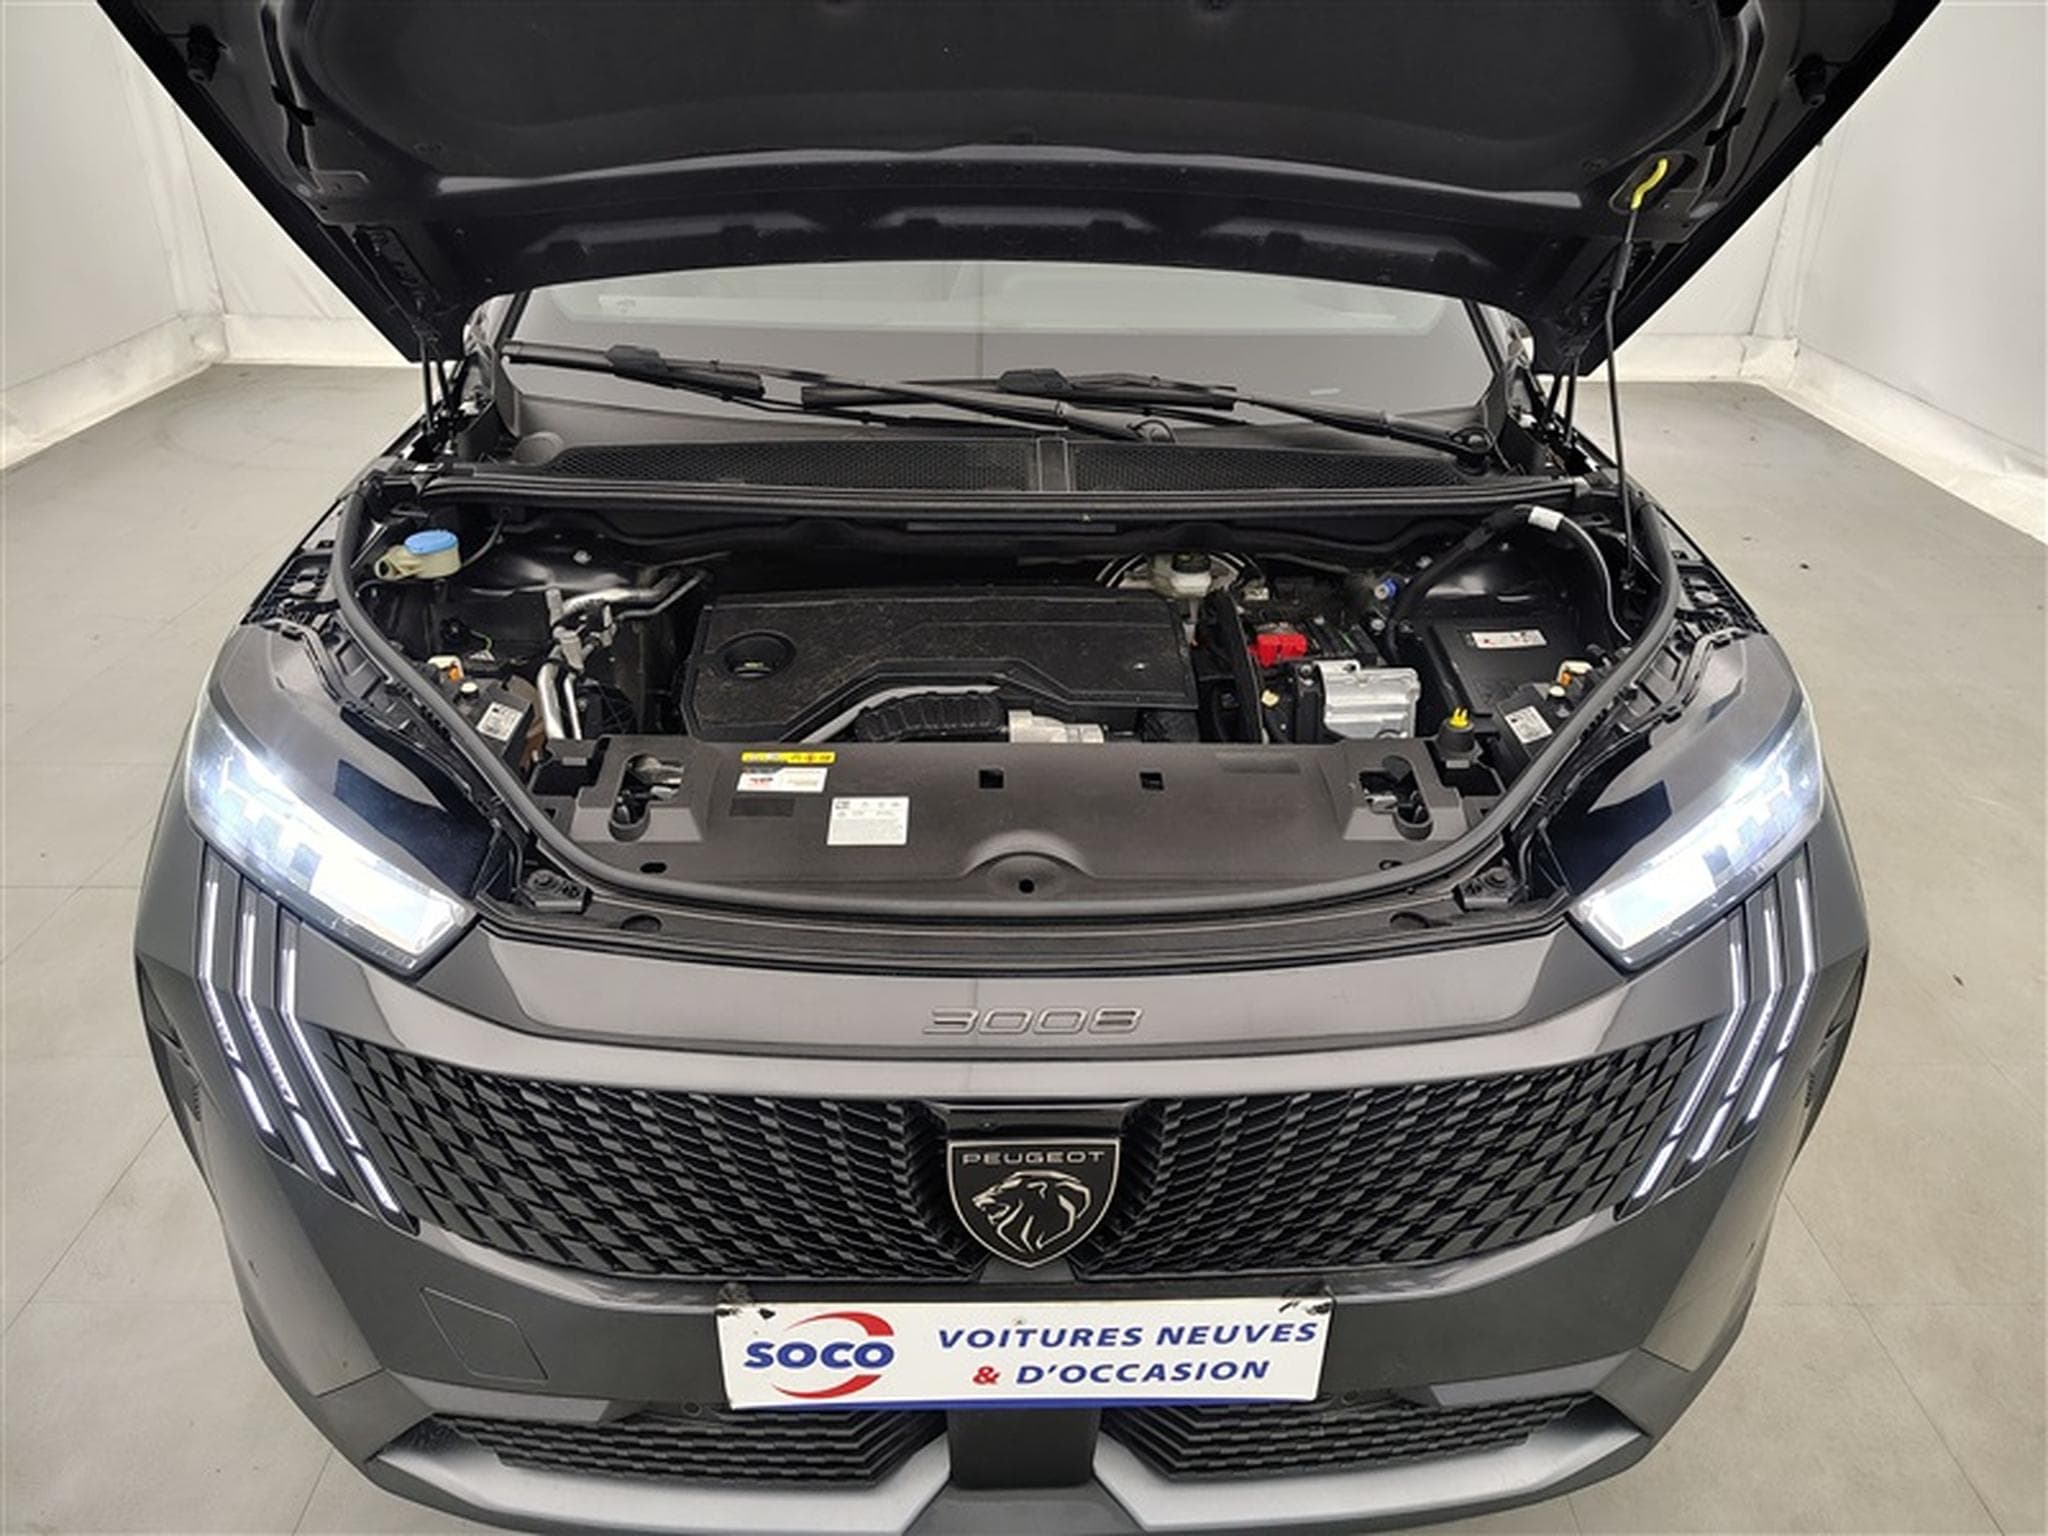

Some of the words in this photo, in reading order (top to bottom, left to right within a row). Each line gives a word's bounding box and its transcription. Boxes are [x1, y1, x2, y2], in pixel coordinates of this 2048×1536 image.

[923, 1007, 1142, 1036] 3008
[962, 1151, 1105, 1165] PEUGEOT
[938, 1327, 1144, 1349] VOITURES
[1155, 1322, 1318, 1346] NEUVES
[744, 1341, 895, 1369] SOCO
[972, 1366, 1000, 1385] &
[1016, 1360, 1270, 1385] D'OCCASION
